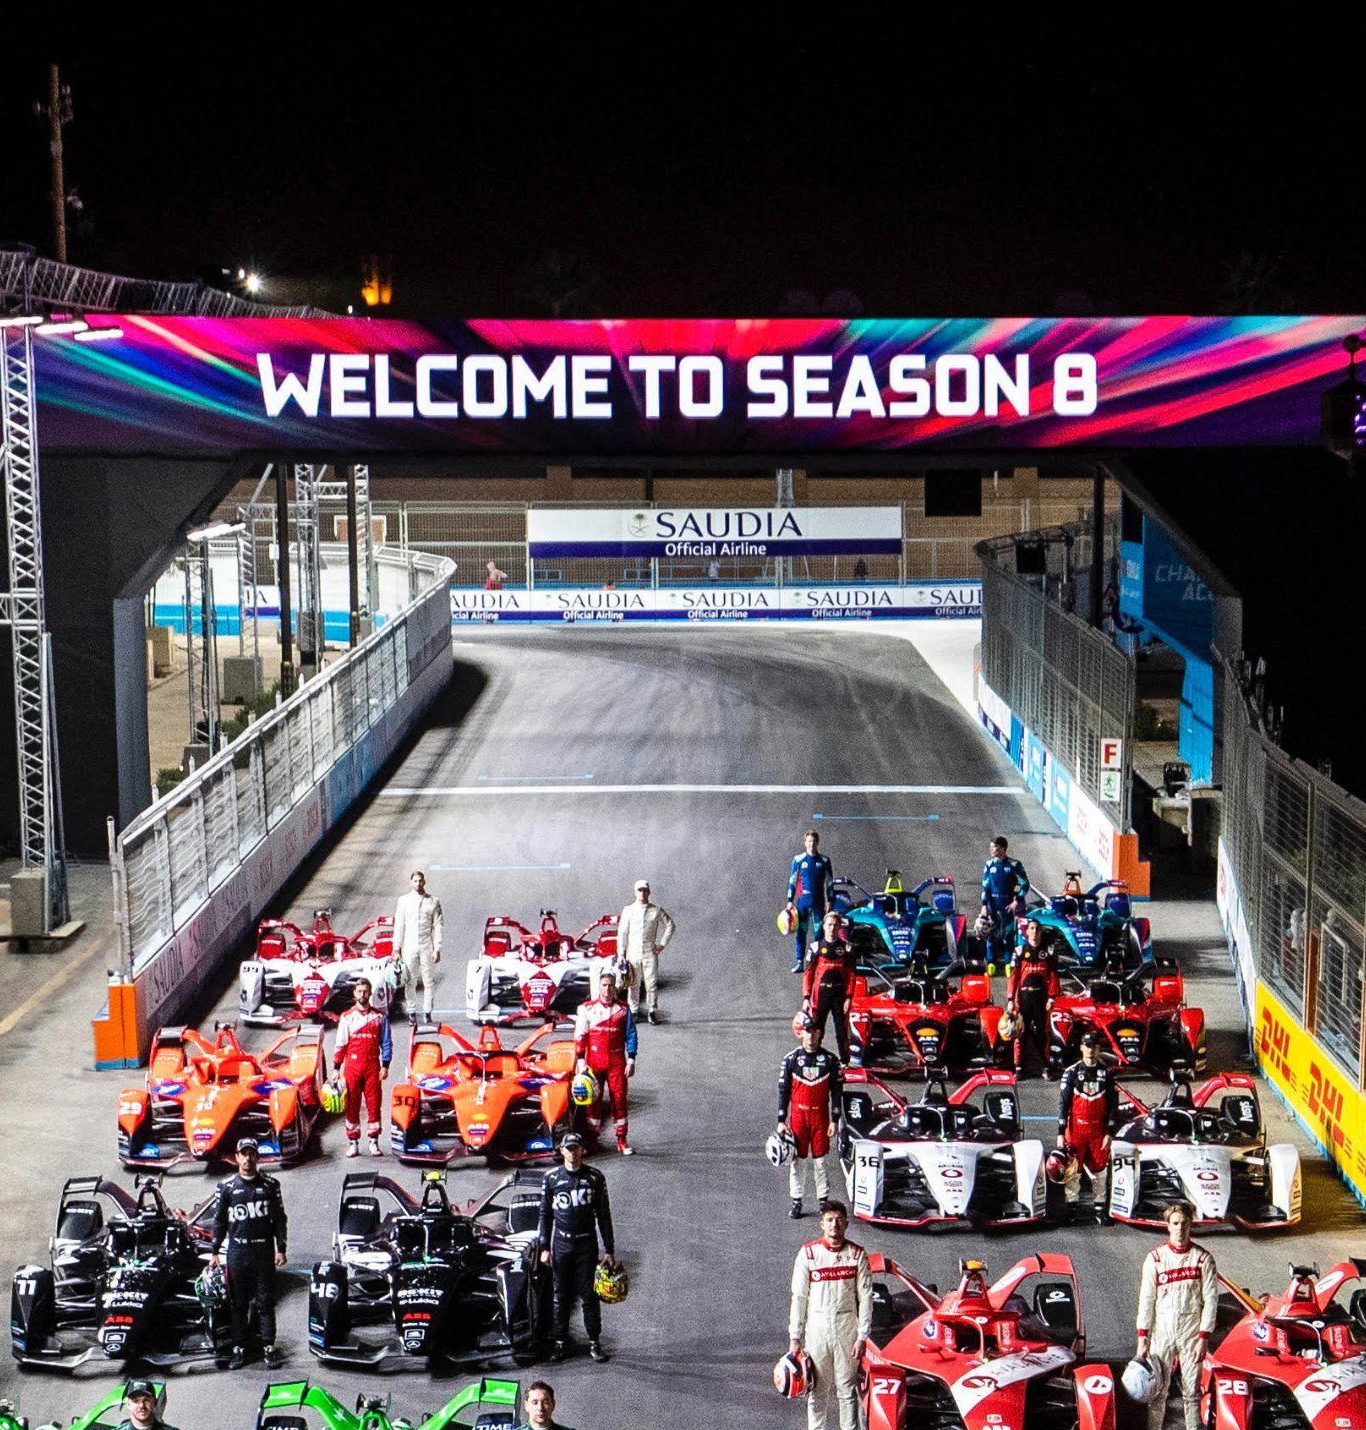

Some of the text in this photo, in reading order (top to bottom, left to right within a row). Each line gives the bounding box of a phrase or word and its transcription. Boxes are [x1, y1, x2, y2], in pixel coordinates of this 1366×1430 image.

[256, 352, 1099, 419] WELCOME TO SEASON 8
[655, 511, 803, 539] SAUDIA
[664, 542, 767, 557] Official Airline
[451, 592, 520, 609] AUDIA
[557, 592, 645, 609] SAUDIA
[682, 592, 770, 608] SAUDIA
[806, 590, 893, 607] SAUDIA
[562, 611, 625, 621] Official Airline
[687, 609, 749, 620] Official Airline
[811, 608, 872, 619] Official Airline
[1103, 743, 1117, 764] F
[1259, 1006, 1292, 1080] DHL
[392, 1094, 416, 1108] 30
[999, 1097, 1014, 1120] Ansys
[1308, 1060, 1345, 1150] DHL
[1239, 1100, 1254, 1123] Ansys
[857, 1155, 880, 1168] 36
[16, 1279, 37, 1296] 11
[104, 1316, 134, 1325] ABB
[402, 1312, 431, 1321] ABB
[872, 1378, 901, 1395] 27
[1218, 1379, 1248, 1395] 28
